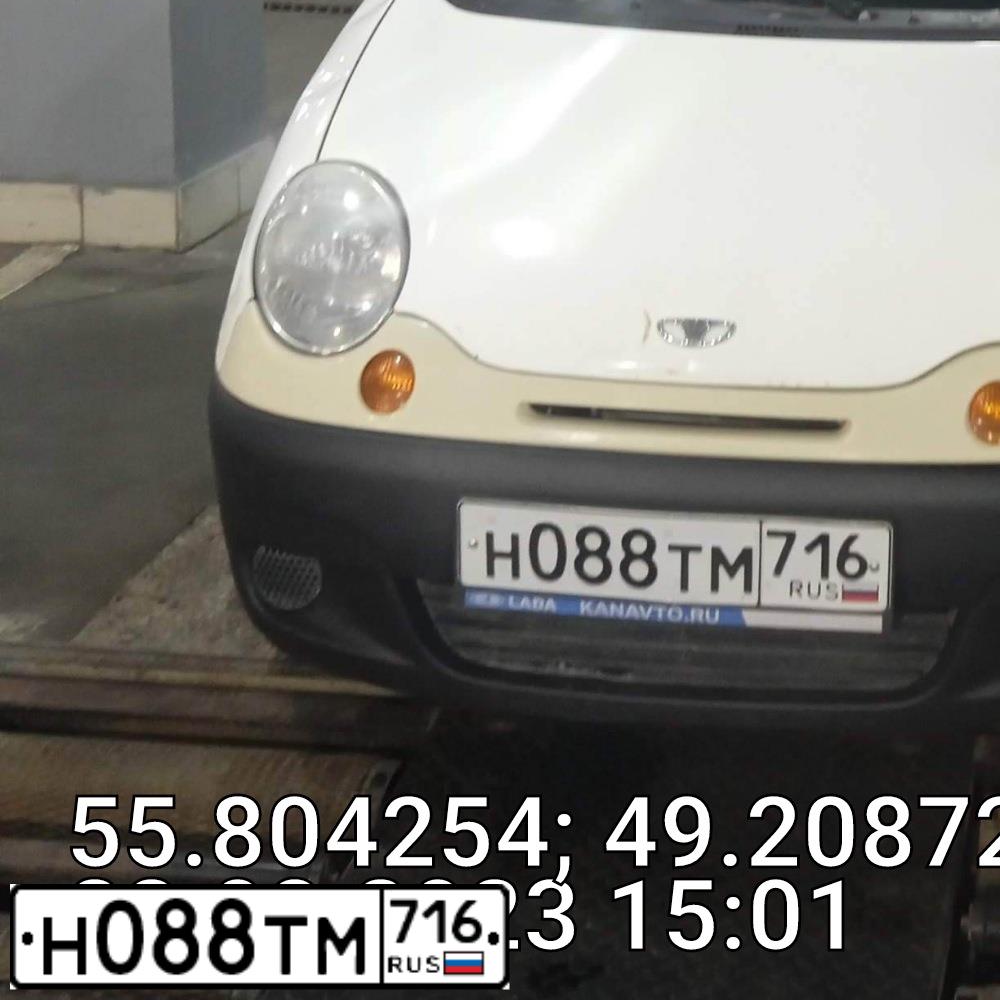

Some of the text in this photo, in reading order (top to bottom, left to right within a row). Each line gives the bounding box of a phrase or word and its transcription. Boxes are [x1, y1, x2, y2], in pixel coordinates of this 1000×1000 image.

[485, 521, 869, 594] Н088ТМ 716
[789, 579, 839, 601] RUS
[508, 594, 720, 625] LADA KANAVTO.RU
